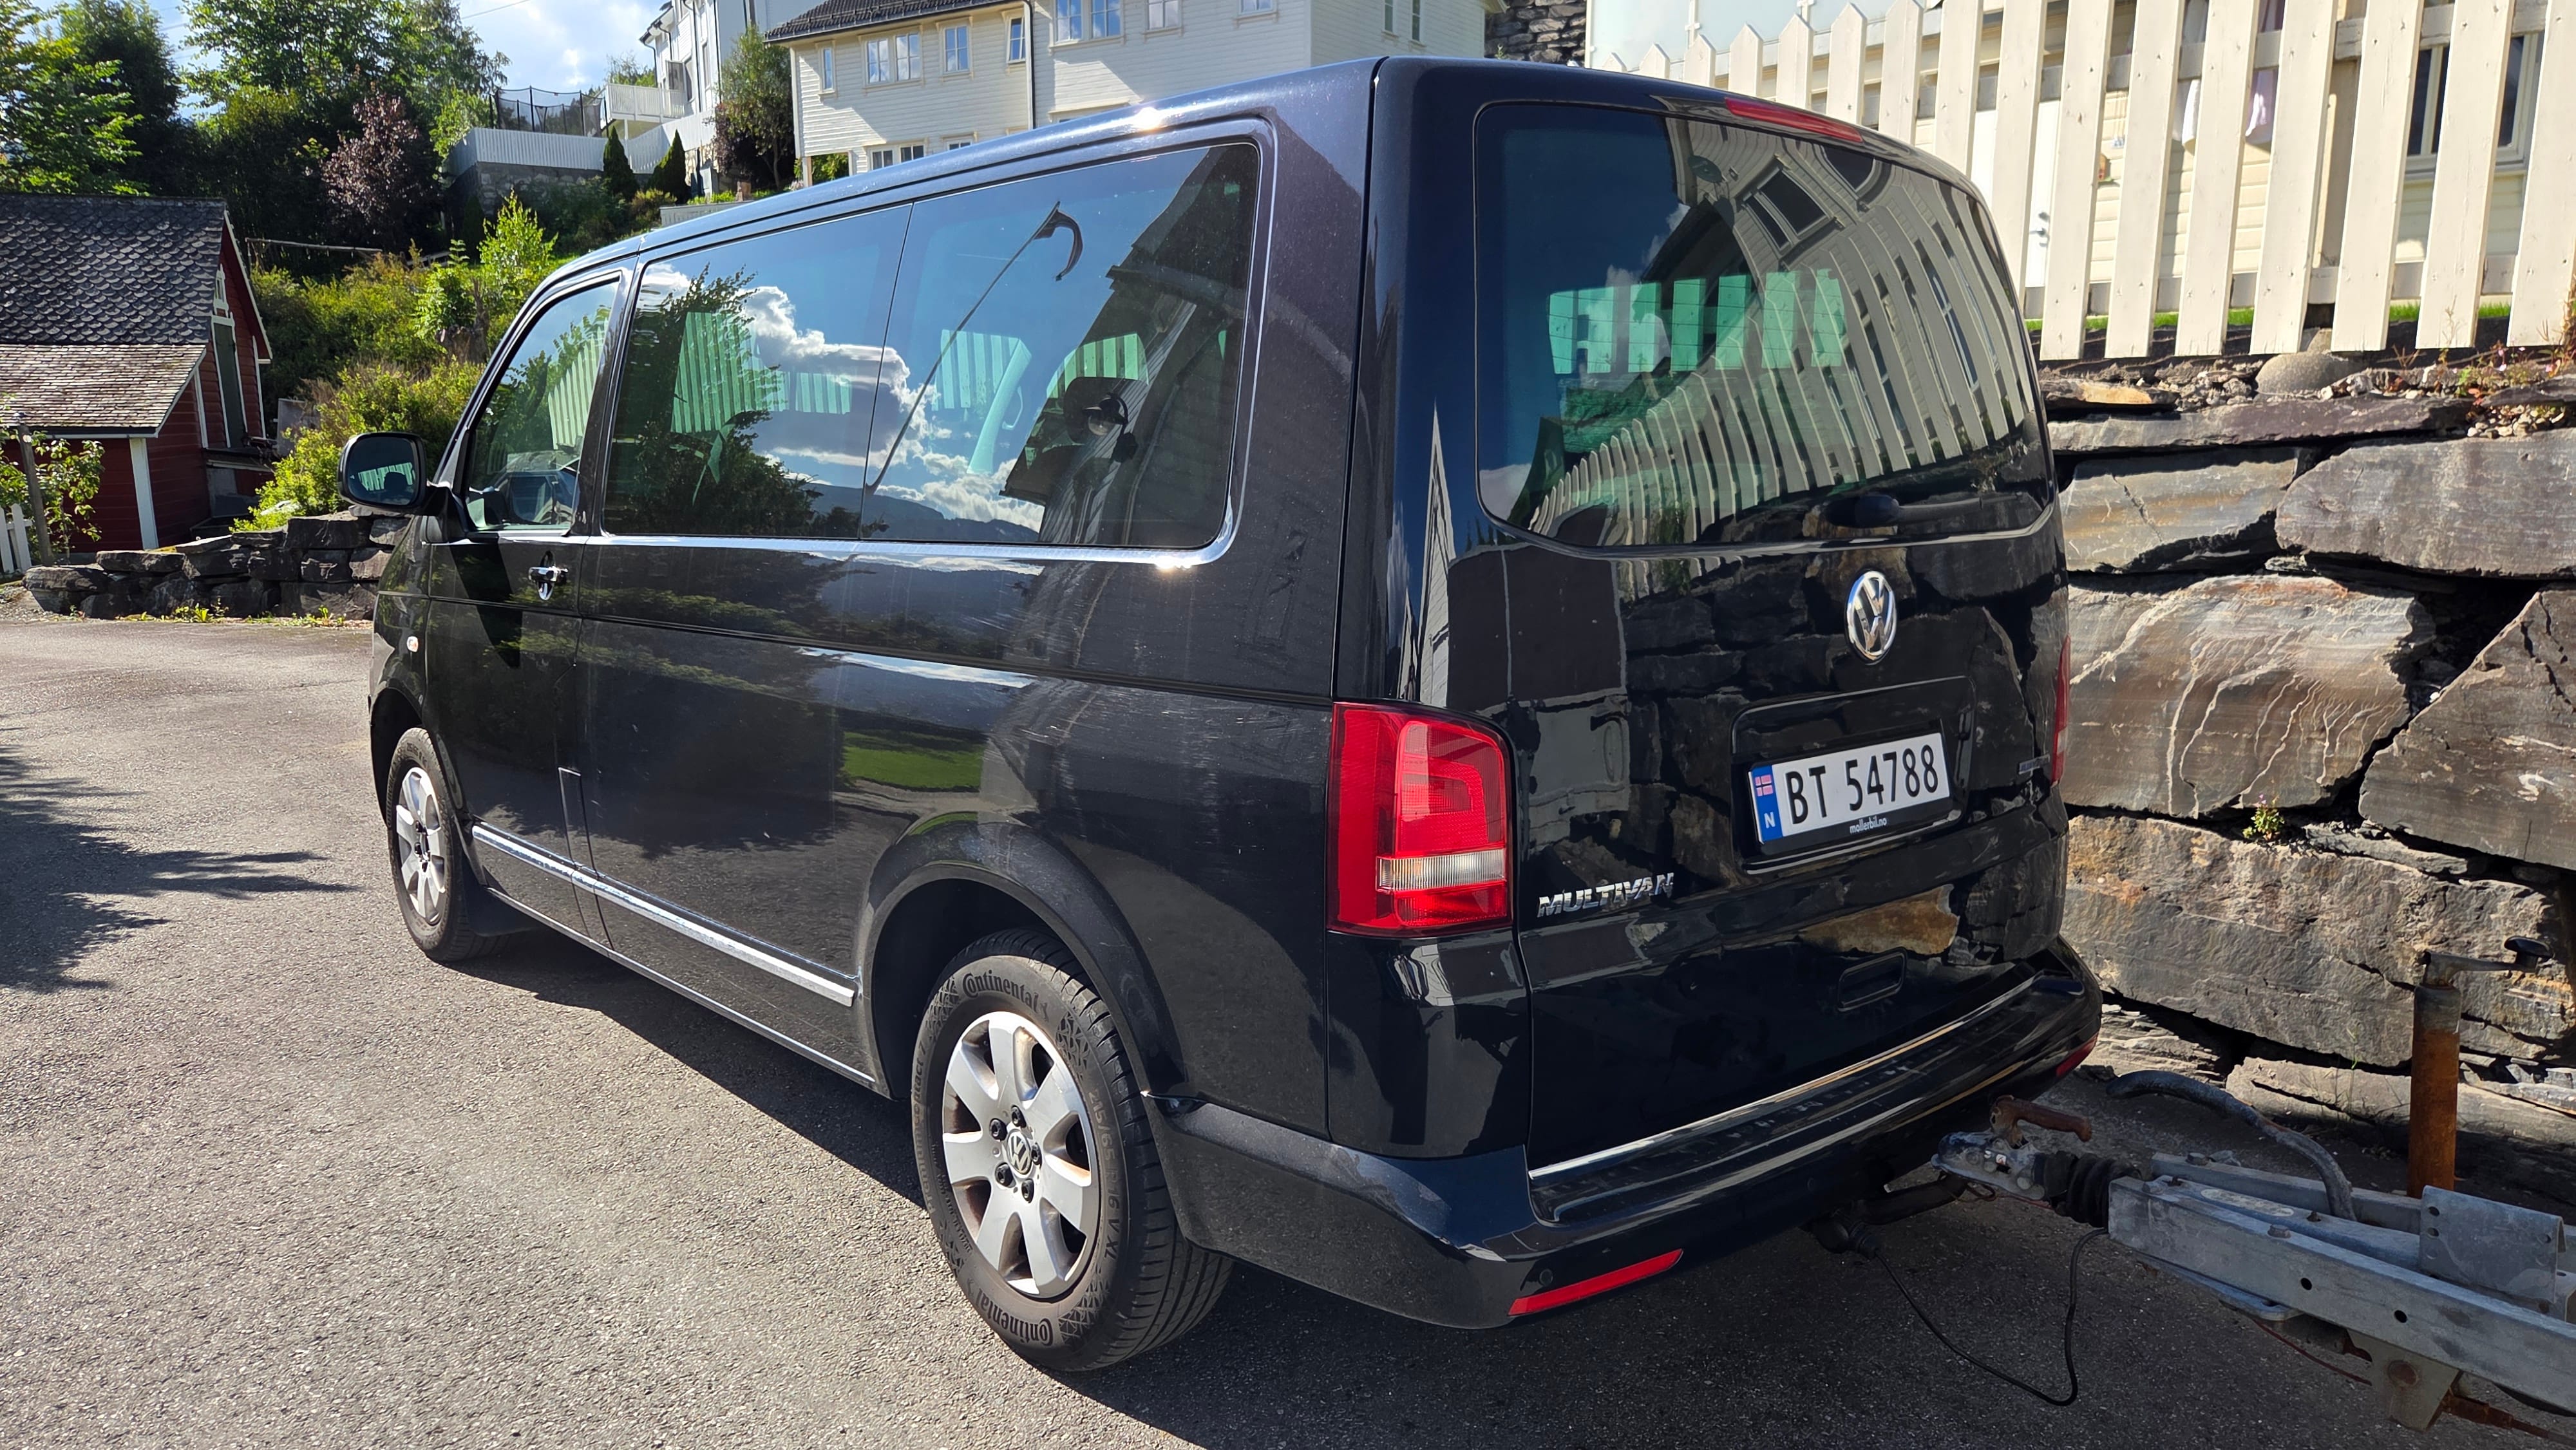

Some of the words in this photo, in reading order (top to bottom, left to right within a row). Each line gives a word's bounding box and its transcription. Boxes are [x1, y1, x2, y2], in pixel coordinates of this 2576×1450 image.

[1785, 765, 1827, 825] BT
[1845, 744, 1938, 811] 54788
[1764, 811, 1776, 829] N
[1849, 814, 1888, 834] mollerbil.no
[1537, 872, 1674, 918] MULTIVAN
[962, 969, 1039, 1014] Continental
[1088, 1089, 1116, 1161] 215/65
[975, 1288, 1054, 1346] Continental
